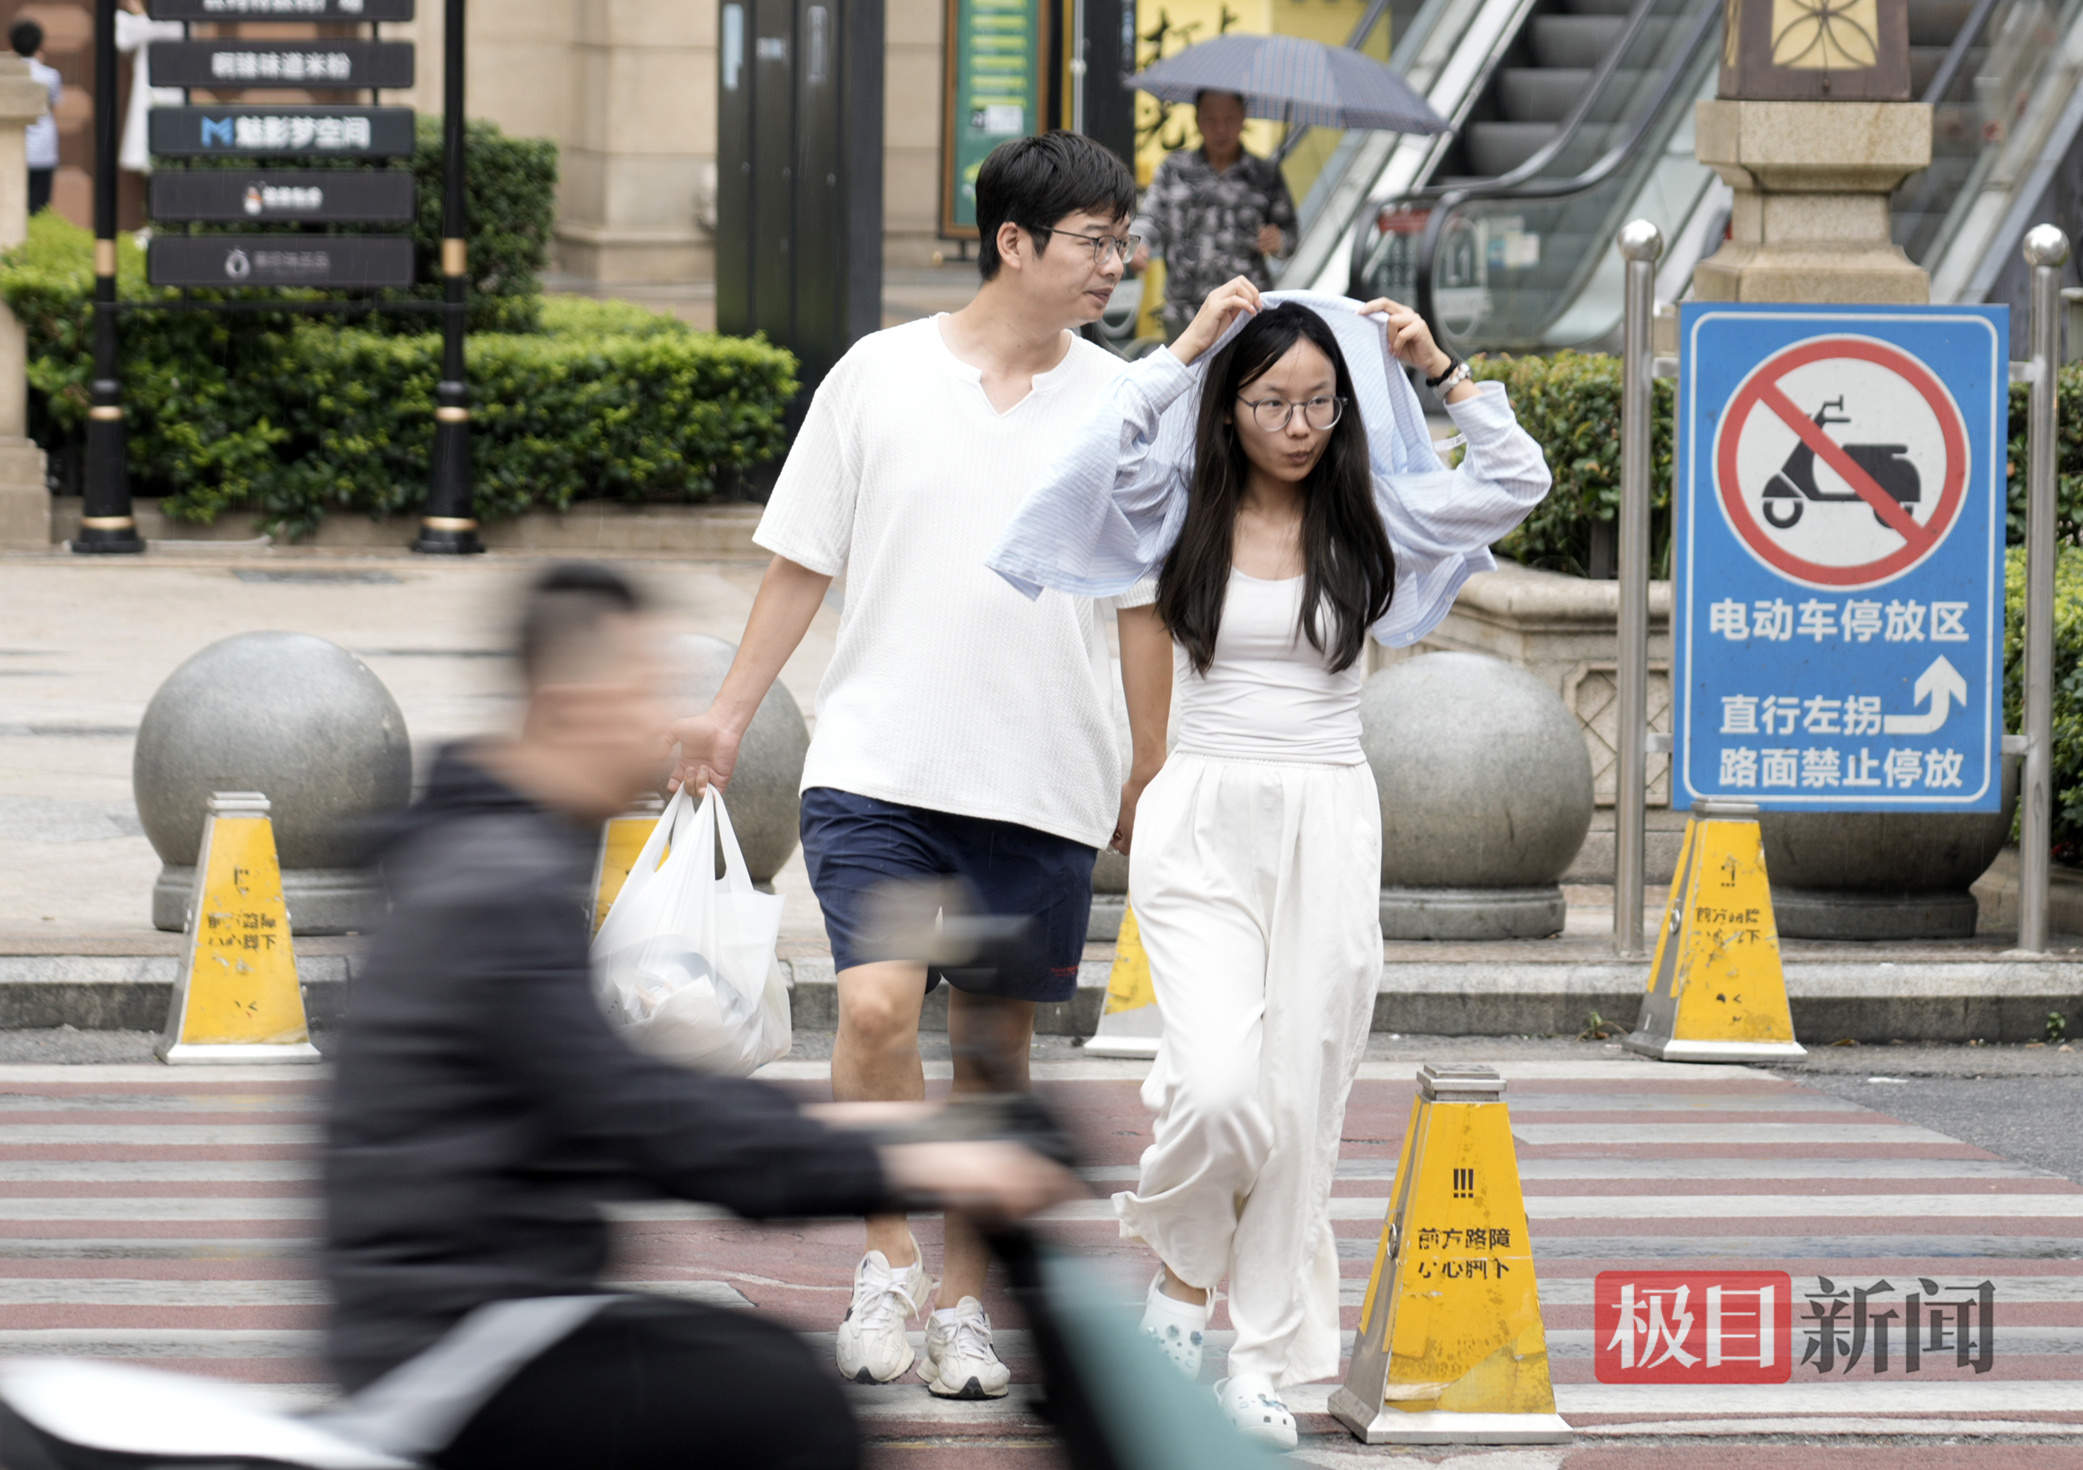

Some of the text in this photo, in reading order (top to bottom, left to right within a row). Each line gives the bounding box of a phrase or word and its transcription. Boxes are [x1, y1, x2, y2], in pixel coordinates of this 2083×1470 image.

[1710, 598, 1969, 642] 电动车停放区
[1720, 694, 1882, 735] 直行左拐
[1719, 746, 1964, 788] 路面禁止停放
[1418, 1227, 1511, 1250] 前方路障
